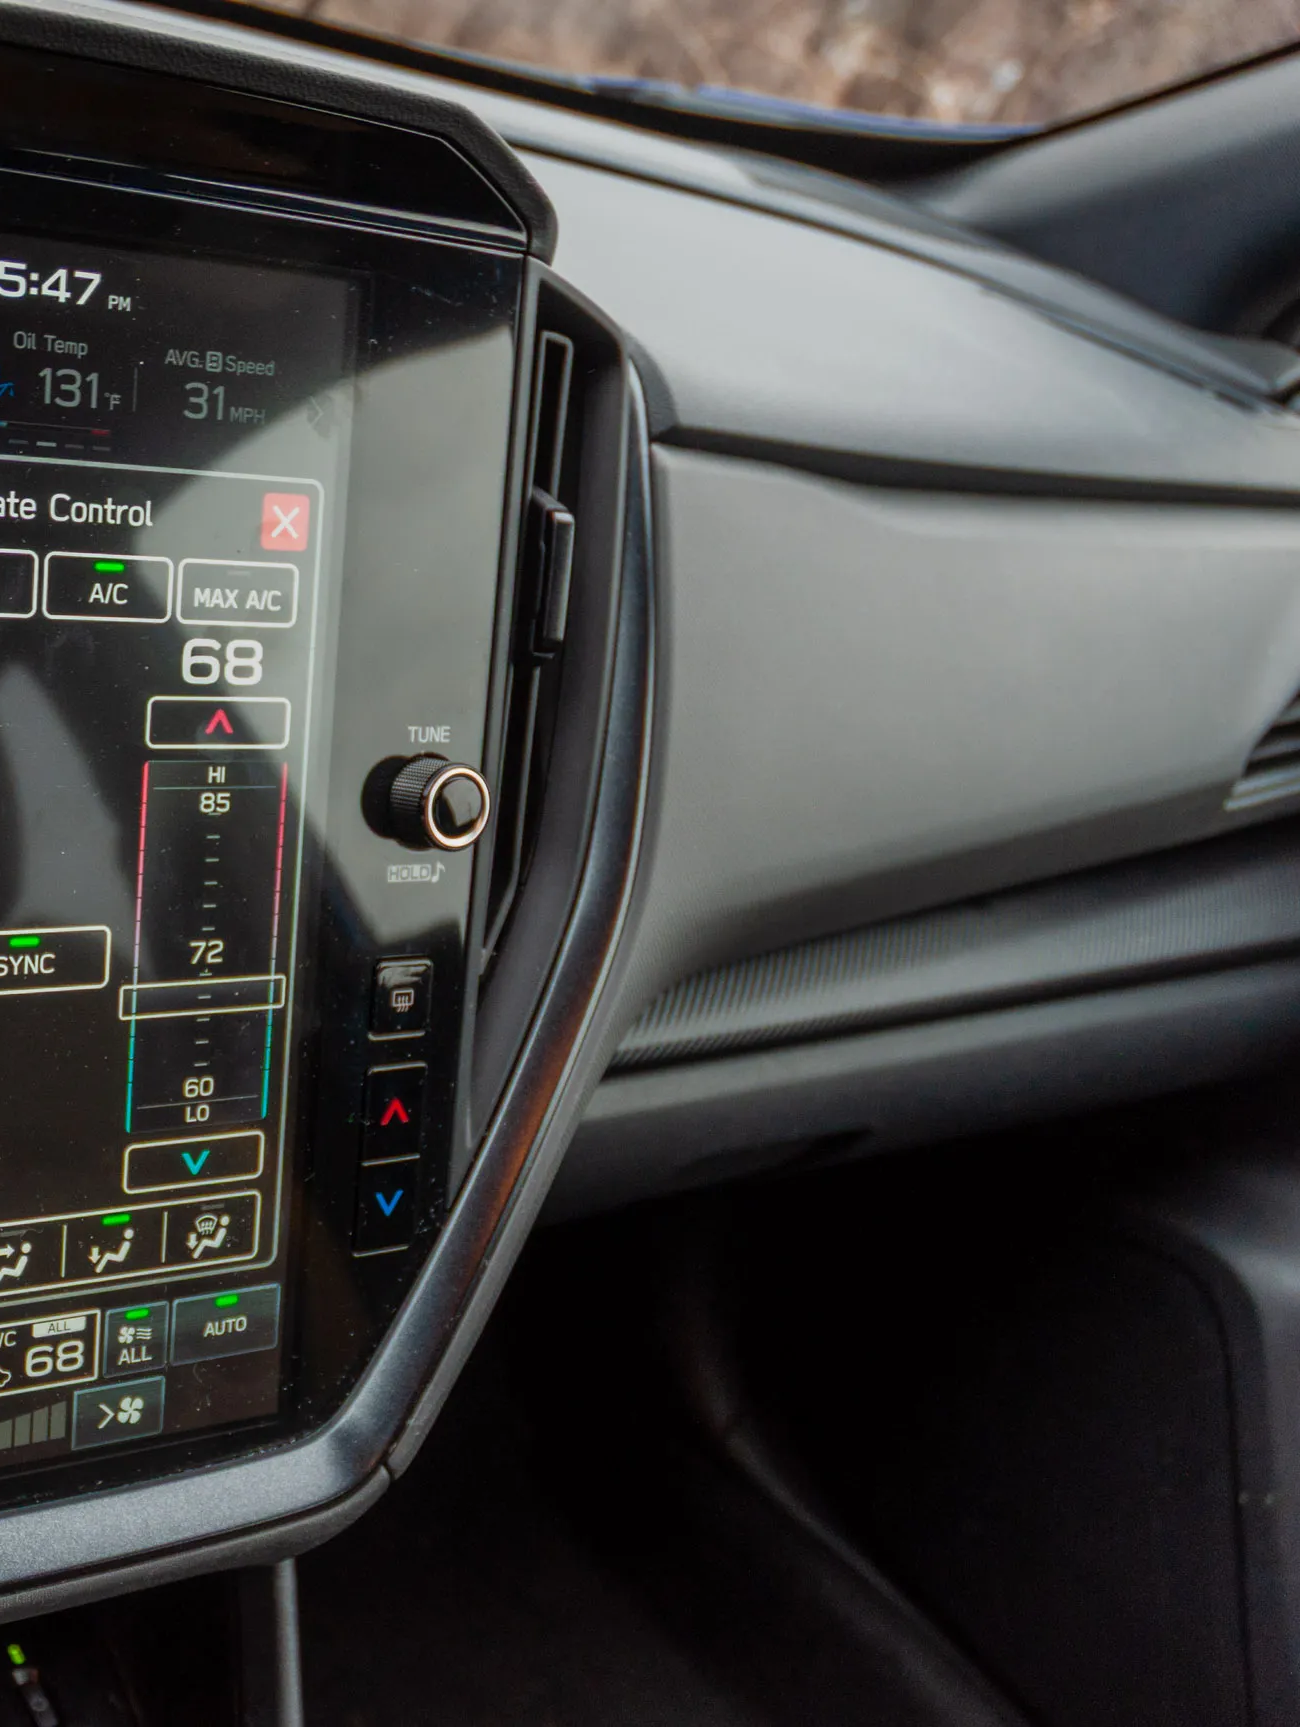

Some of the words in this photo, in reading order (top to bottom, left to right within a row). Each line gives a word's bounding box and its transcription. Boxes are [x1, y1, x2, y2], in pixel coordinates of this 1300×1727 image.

[108, 295, 131, 311] PM
[13, 331, 37, 350] Oil
[44, 334, 89, 359] Temp
[225, 355, 275, 377] Speed
[38, 367, 100, 409] 131
[183, 382, 225, 421] 31
[229, 405, 266, 425] MPH
[49, 493, 153, 528] Control
[90, 582, 129, 606] A/C
[193, 587, 238, 608] MAX
[245, 589, 282, 612] A/C
[182, 639, 264, 685] 68
[408, 726, 451, 743] TUNE
[208, 766, 226, 783] HI
[200, 793, 231, 814] 85
[387, 864, 431, 882] HOLD
[190, 941, 224, 964] 72
[183, 1077, 215, 1098] 60
[185, 1105, 210, 1123] LO
[47, 1321, 73, 1336] ALL
[203, 1316, 248, 1338] AUTO
[25, 1340, 85, 1378] 68
[118, 1346, 153, 1366] ALL
